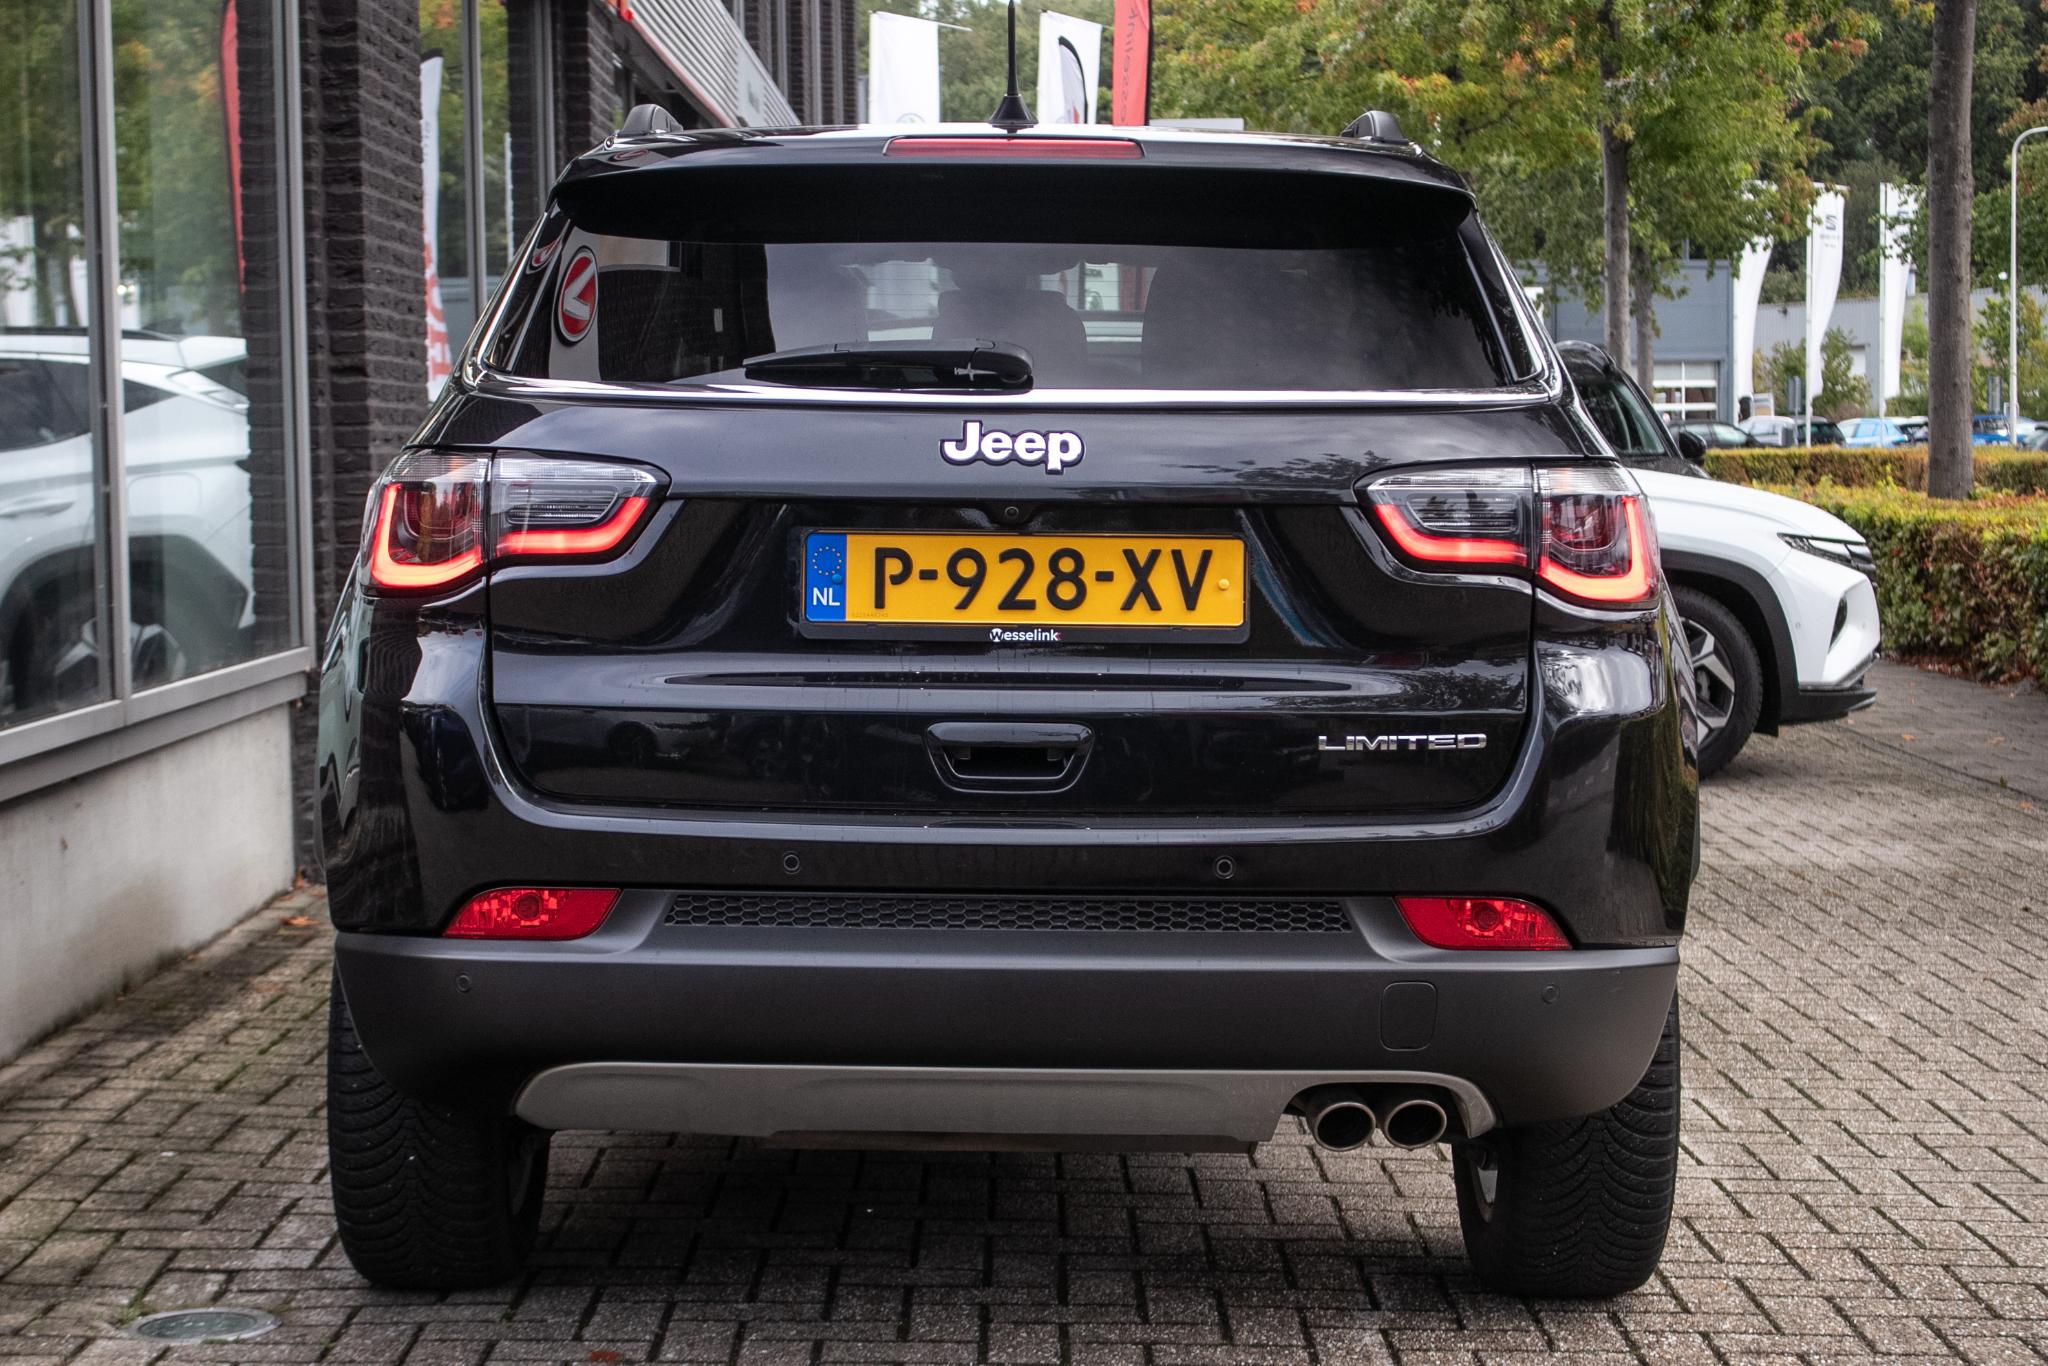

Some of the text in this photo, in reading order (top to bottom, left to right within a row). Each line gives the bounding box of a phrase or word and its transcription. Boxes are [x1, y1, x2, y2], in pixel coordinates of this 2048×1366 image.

[941, 420, 1084, 474] Jeep
[874, 546, 1213, 611] P-928-XV
[812, 586, 841, 606] NL
[990, 627, 1058, 642] Wesselink
[1318, 733, 1487, 751] LIMITED
